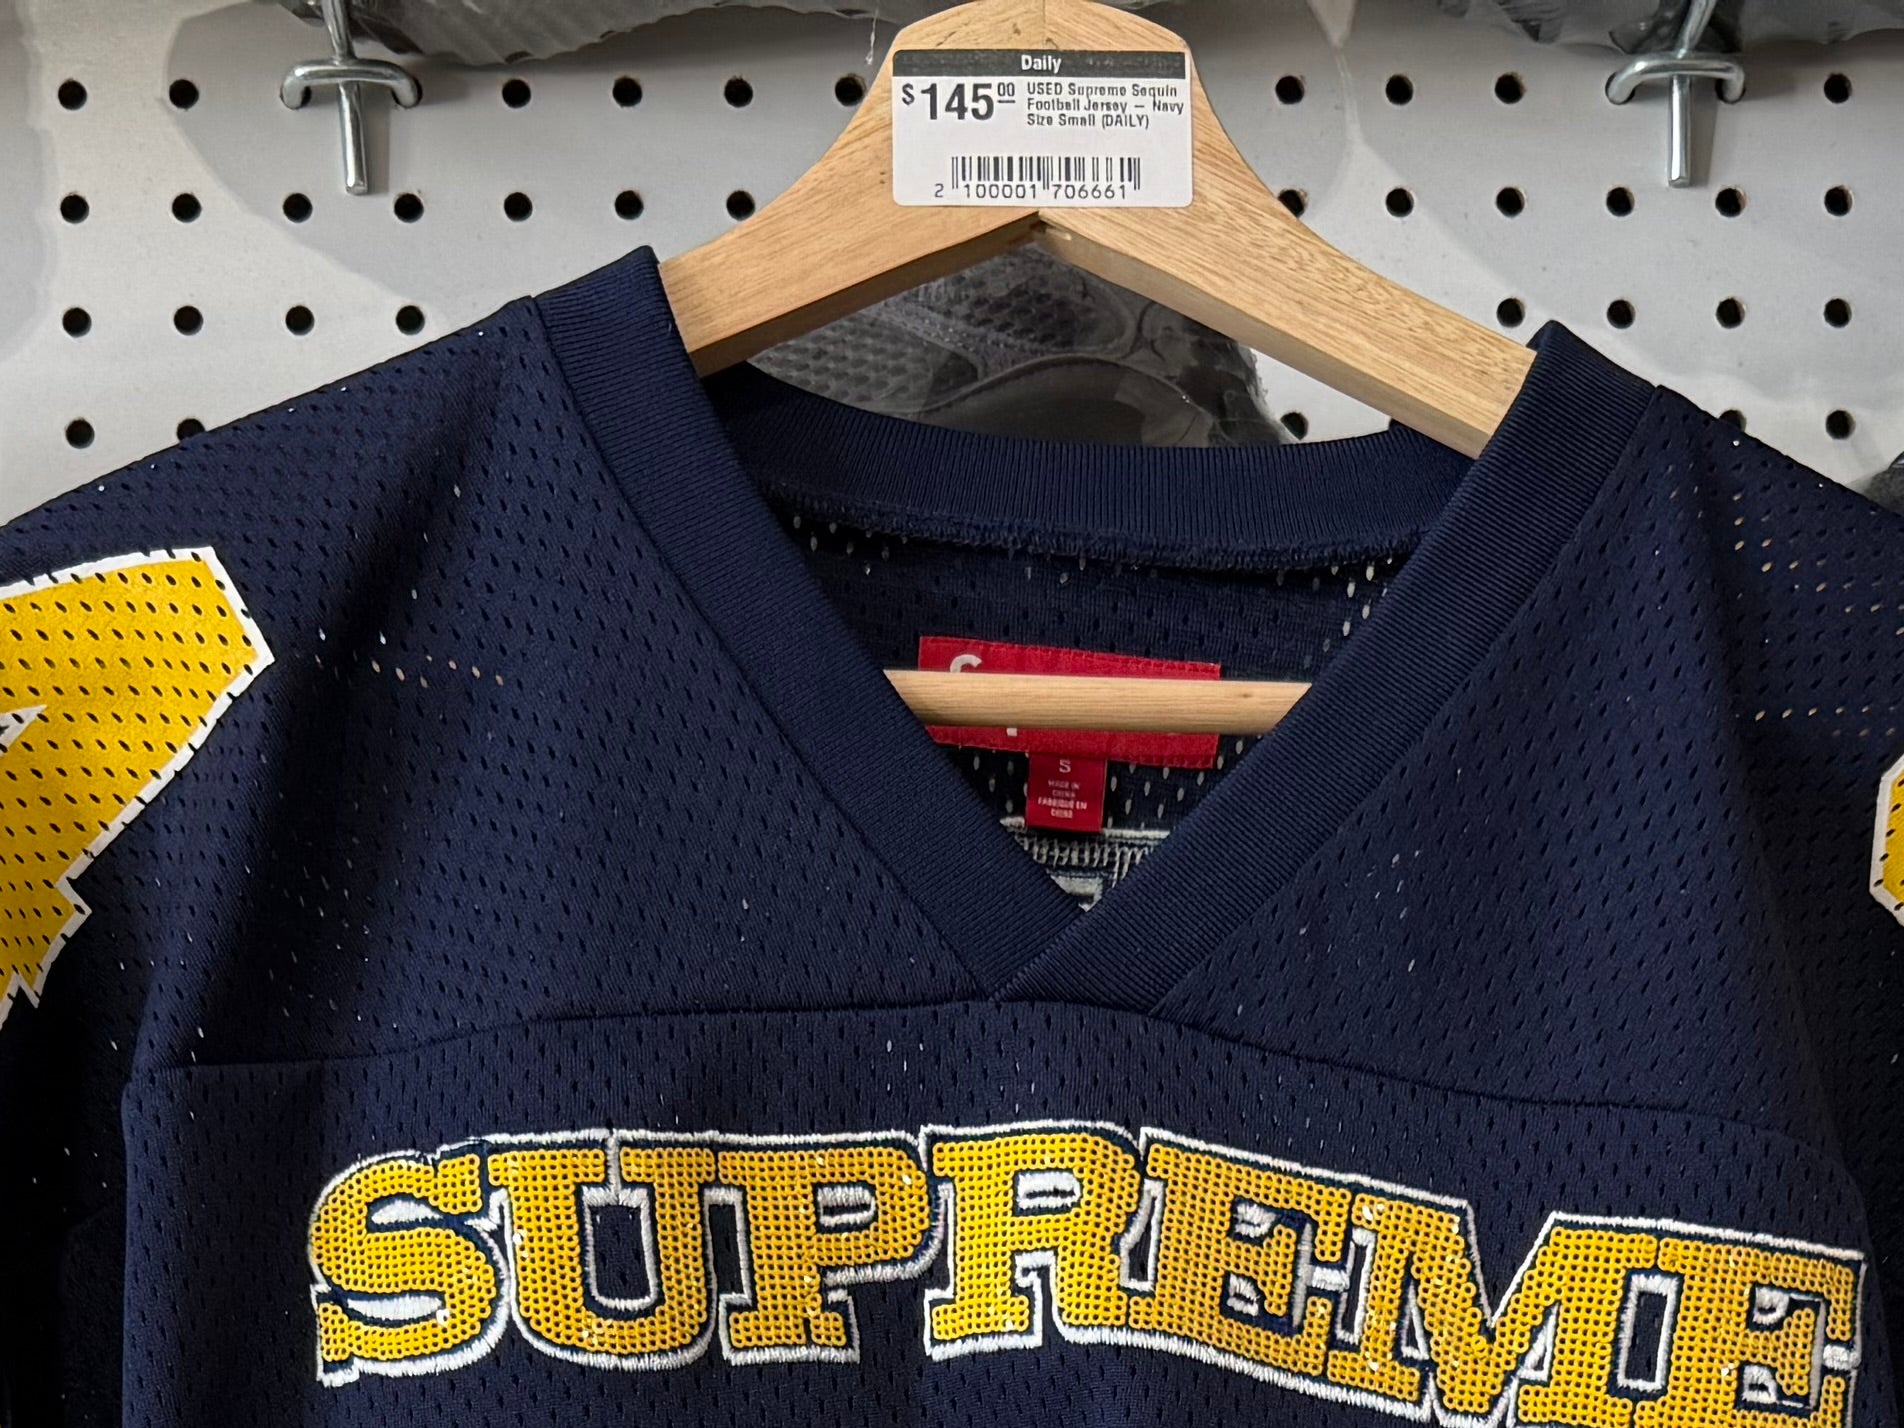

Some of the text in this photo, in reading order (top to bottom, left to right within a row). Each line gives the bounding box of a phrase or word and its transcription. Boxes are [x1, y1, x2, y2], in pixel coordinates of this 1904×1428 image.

[1021, 55, 1062, 73] Daily
[1027, 83, 1177, 103] USED Supreme Sequin
[1027, 98, 1081, 112] Football
[1083, 99, 1127, 114] Jersey
[1152, 100, 1184, 115] Navy
[1027, 113, 1150, 130] Size Small (DAILY)
[934, 184, 1126, 199] 2 100001 706661
[1059, 759, 1071, 773] S
